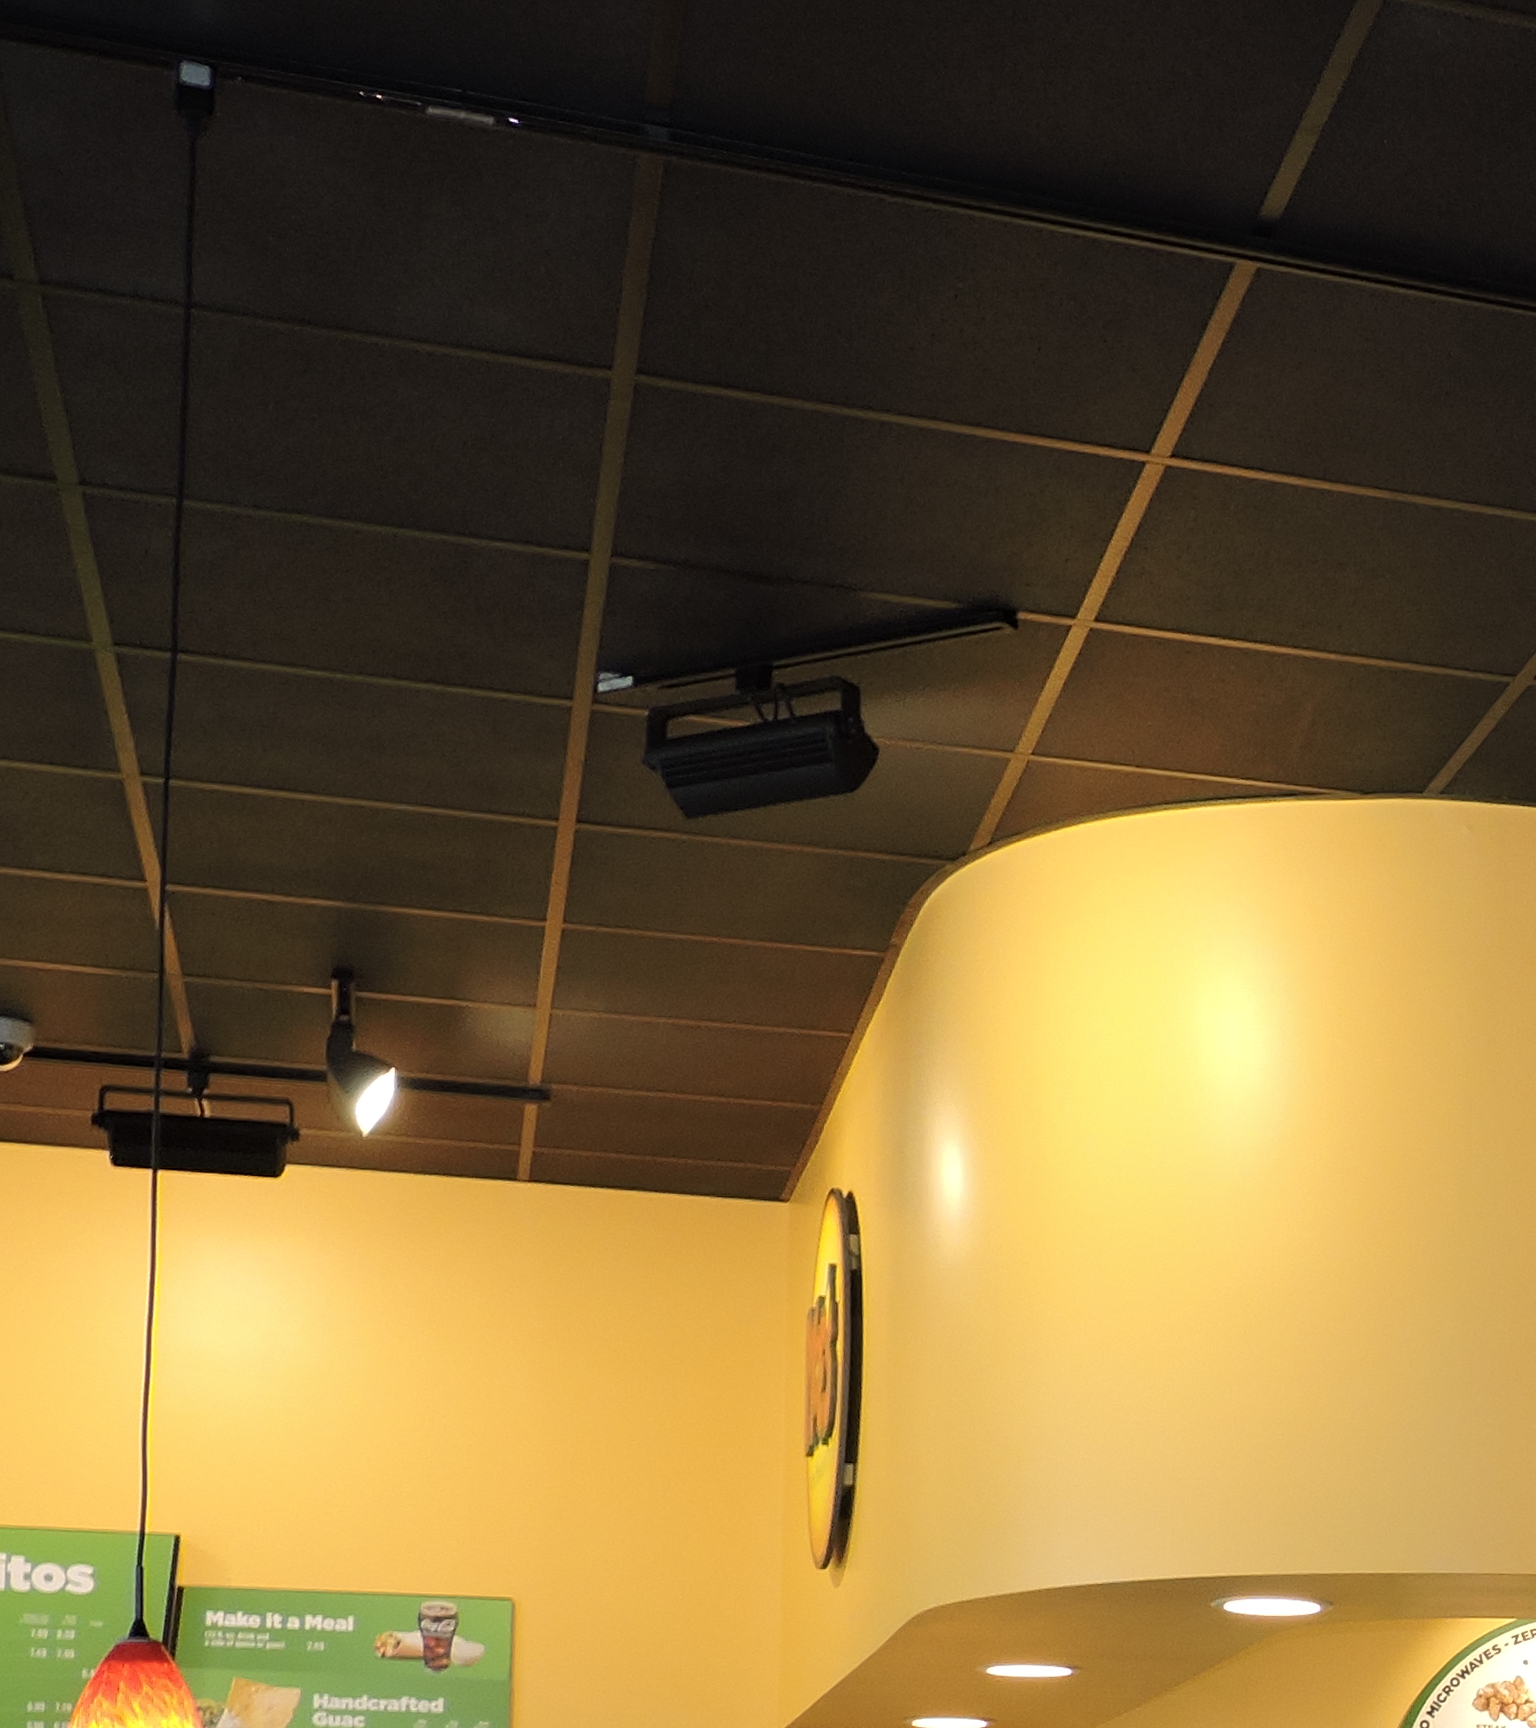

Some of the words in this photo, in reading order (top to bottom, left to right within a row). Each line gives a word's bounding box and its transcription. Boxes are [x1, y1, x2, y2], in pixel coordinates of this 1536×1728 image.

[205, 1610, 261, 1628] Make
[265, 1611, 282, 1628] it
[286, 1616, 300, 1629] a
[304, 1613, 355, 1632] Meal
[1427, 1644, 1502, 1719] MICROWAVES
[312, 1693, 445, 1713] Handcrafted
[311, 1711, 366, 1728] Guac
